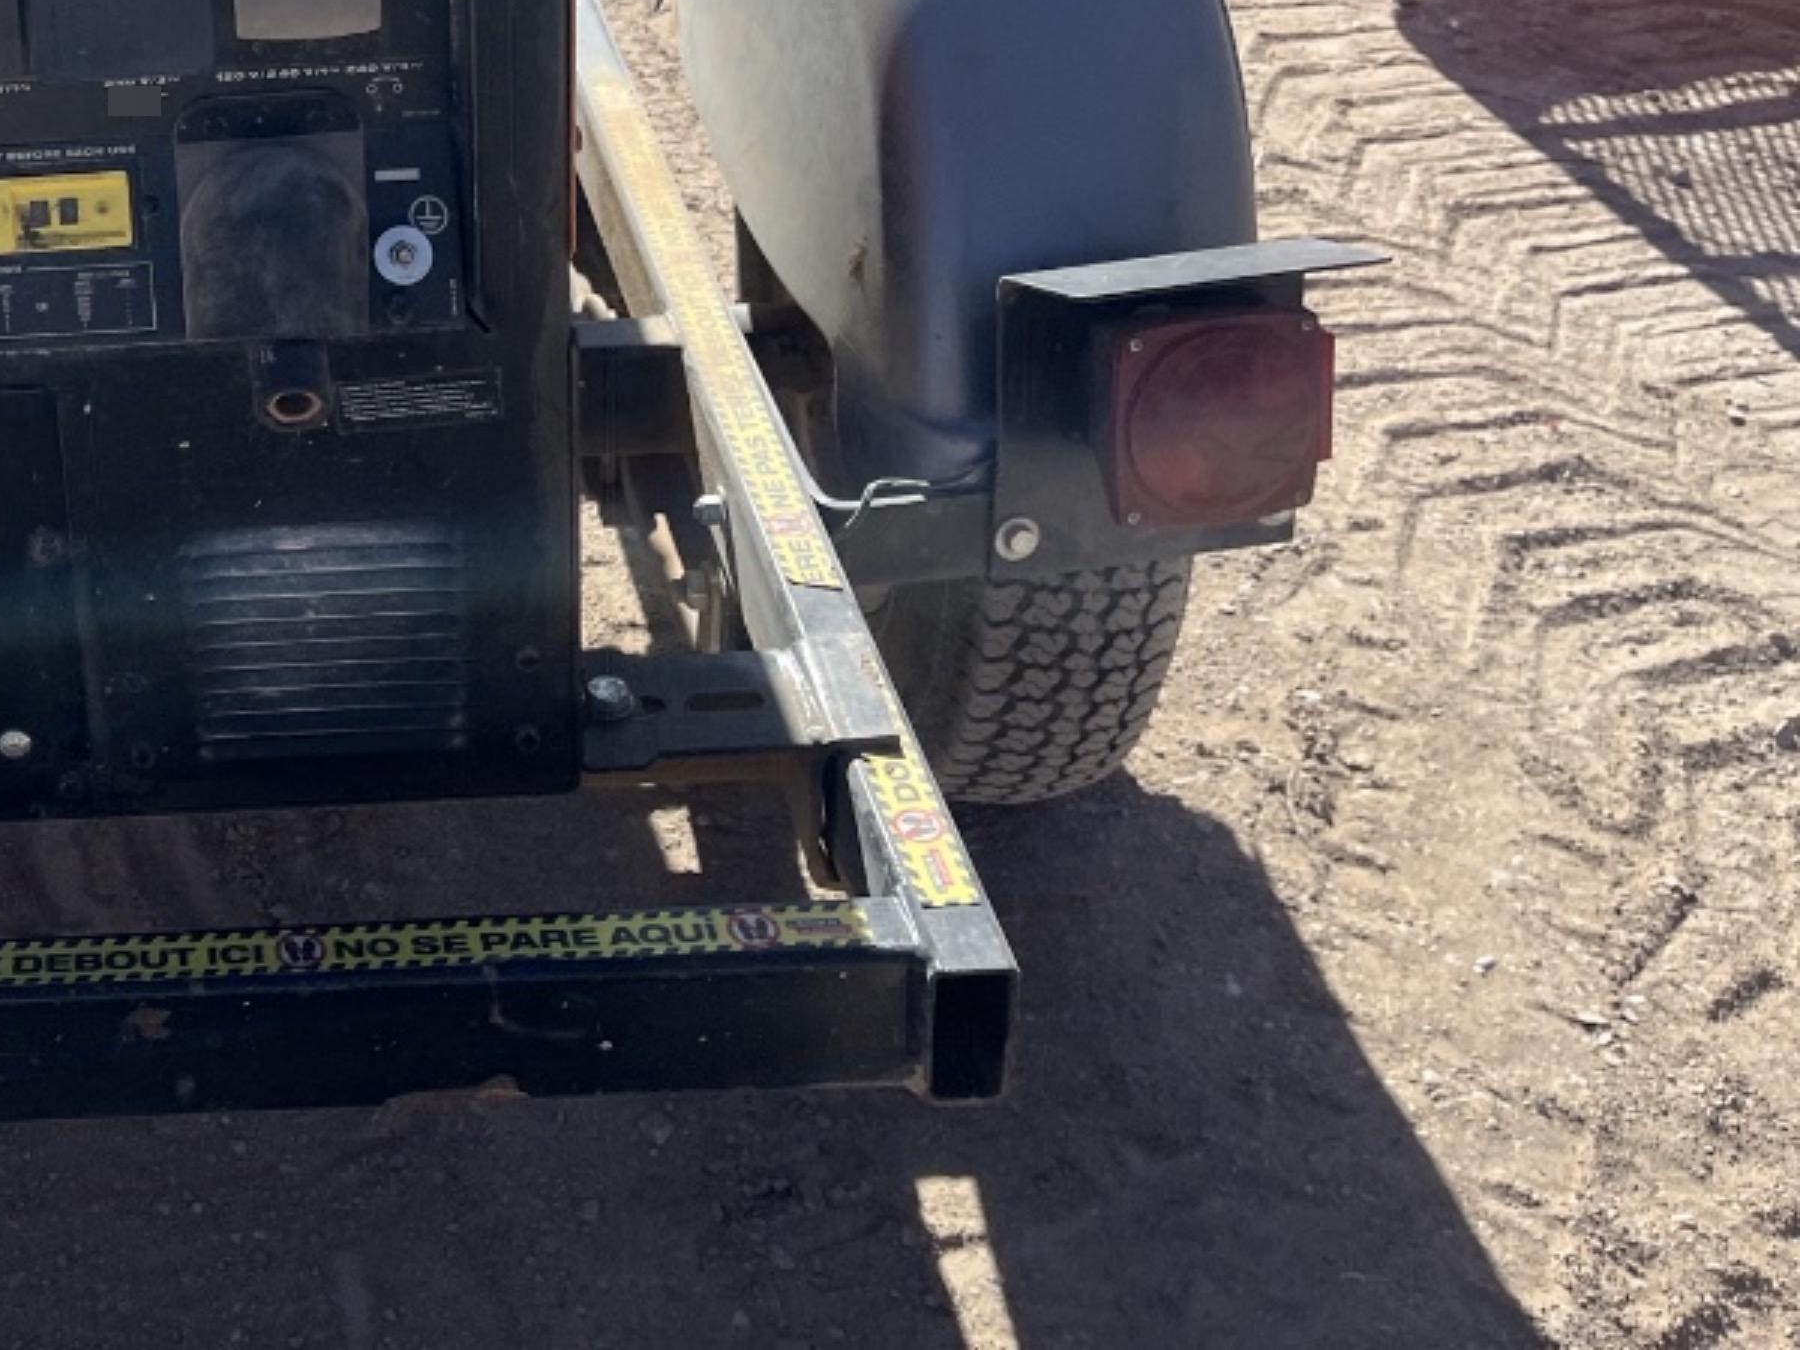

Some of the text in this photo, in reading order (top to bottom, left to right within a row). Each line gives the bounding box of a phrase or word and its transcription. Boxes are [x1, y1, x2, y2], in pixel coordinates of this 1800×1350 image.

[12, 948, 198, 976] DEBOUT
[207, 945, 265, 966] ICI
[334, 937, 401, 961] NO
[410, 933, 469, 955] SE
[480, 928, 600, 952] PARE
